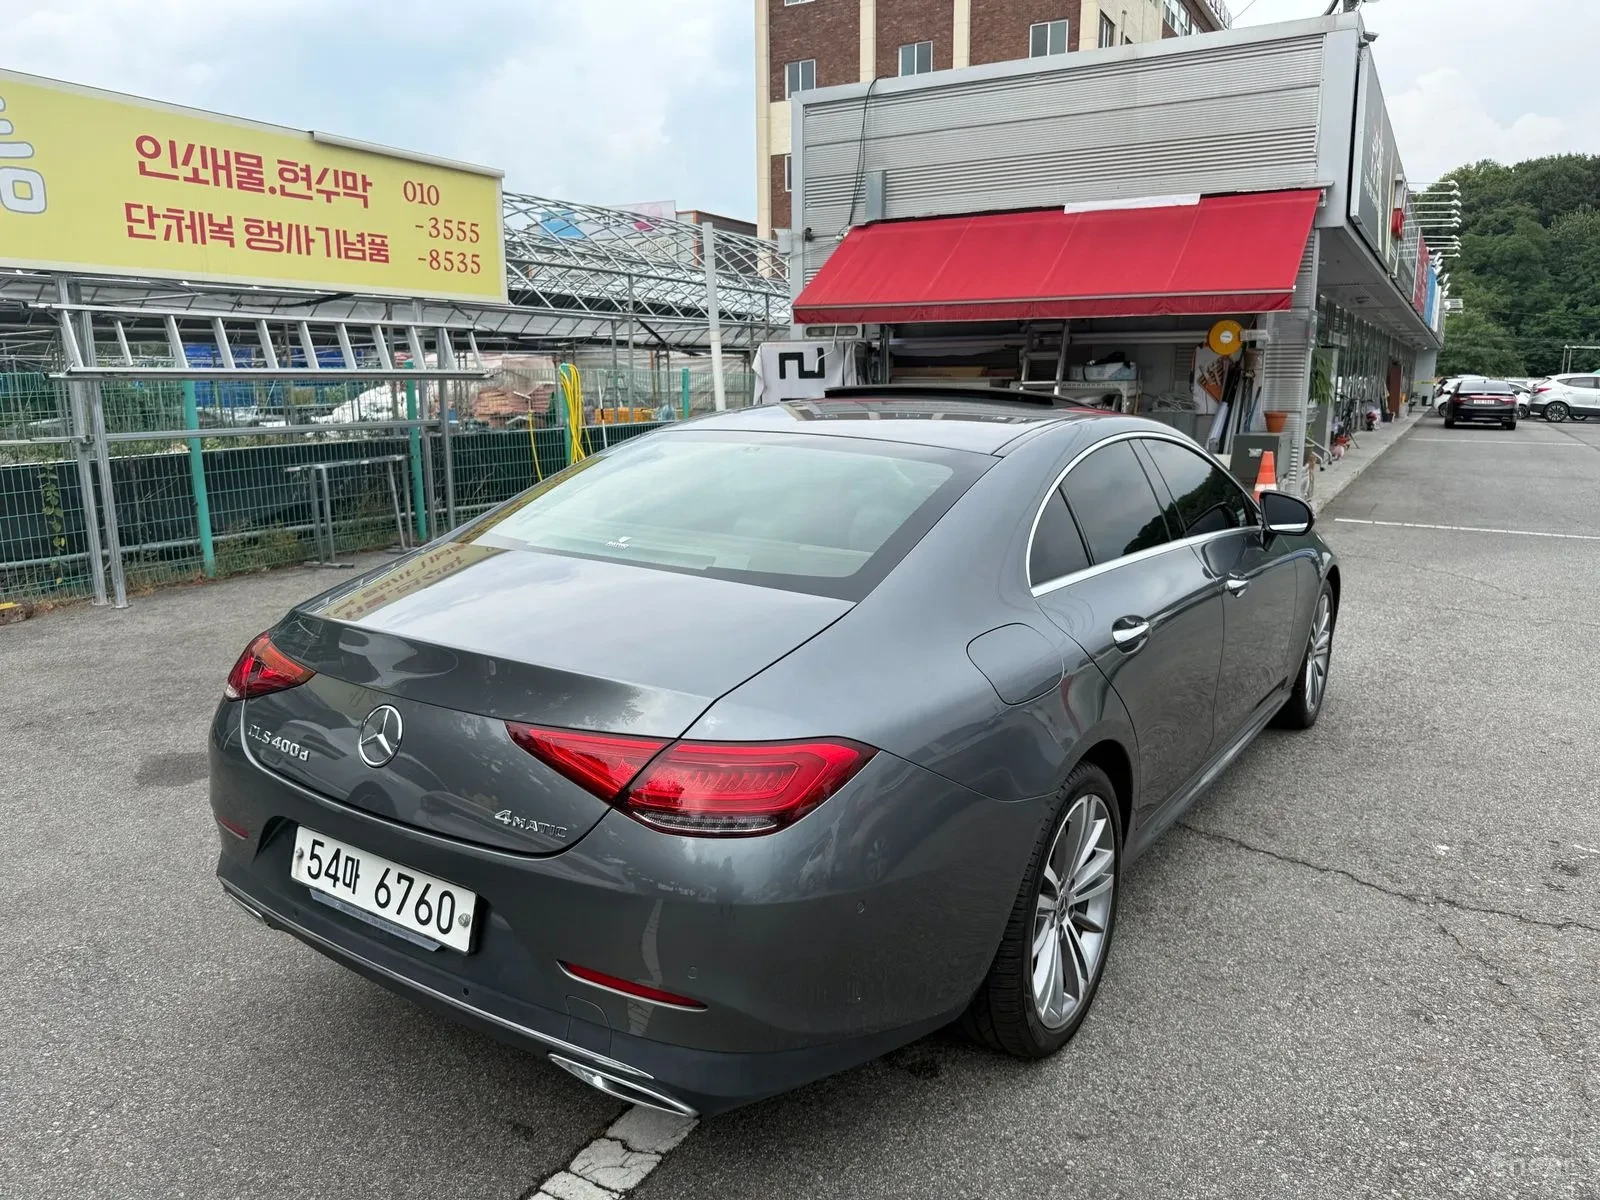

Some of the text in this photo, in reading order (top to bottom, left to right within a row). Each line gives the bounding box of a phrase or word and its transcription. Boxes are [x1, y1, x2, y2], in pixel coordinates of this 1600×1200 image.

[135, 134, 373, 209] 인쇄물.현수막
[403, 180, 440, 206] 010
[124, 202, 390, 264] 단체복 행사기념품
[415, 216, 480, 244] -3555
[417, 248, 481, 275] -8535
[494, 809, 568, 839] 4MATIC
[306, 838, 361, 895] 54마
[374, 867, 457, 935] 6760
